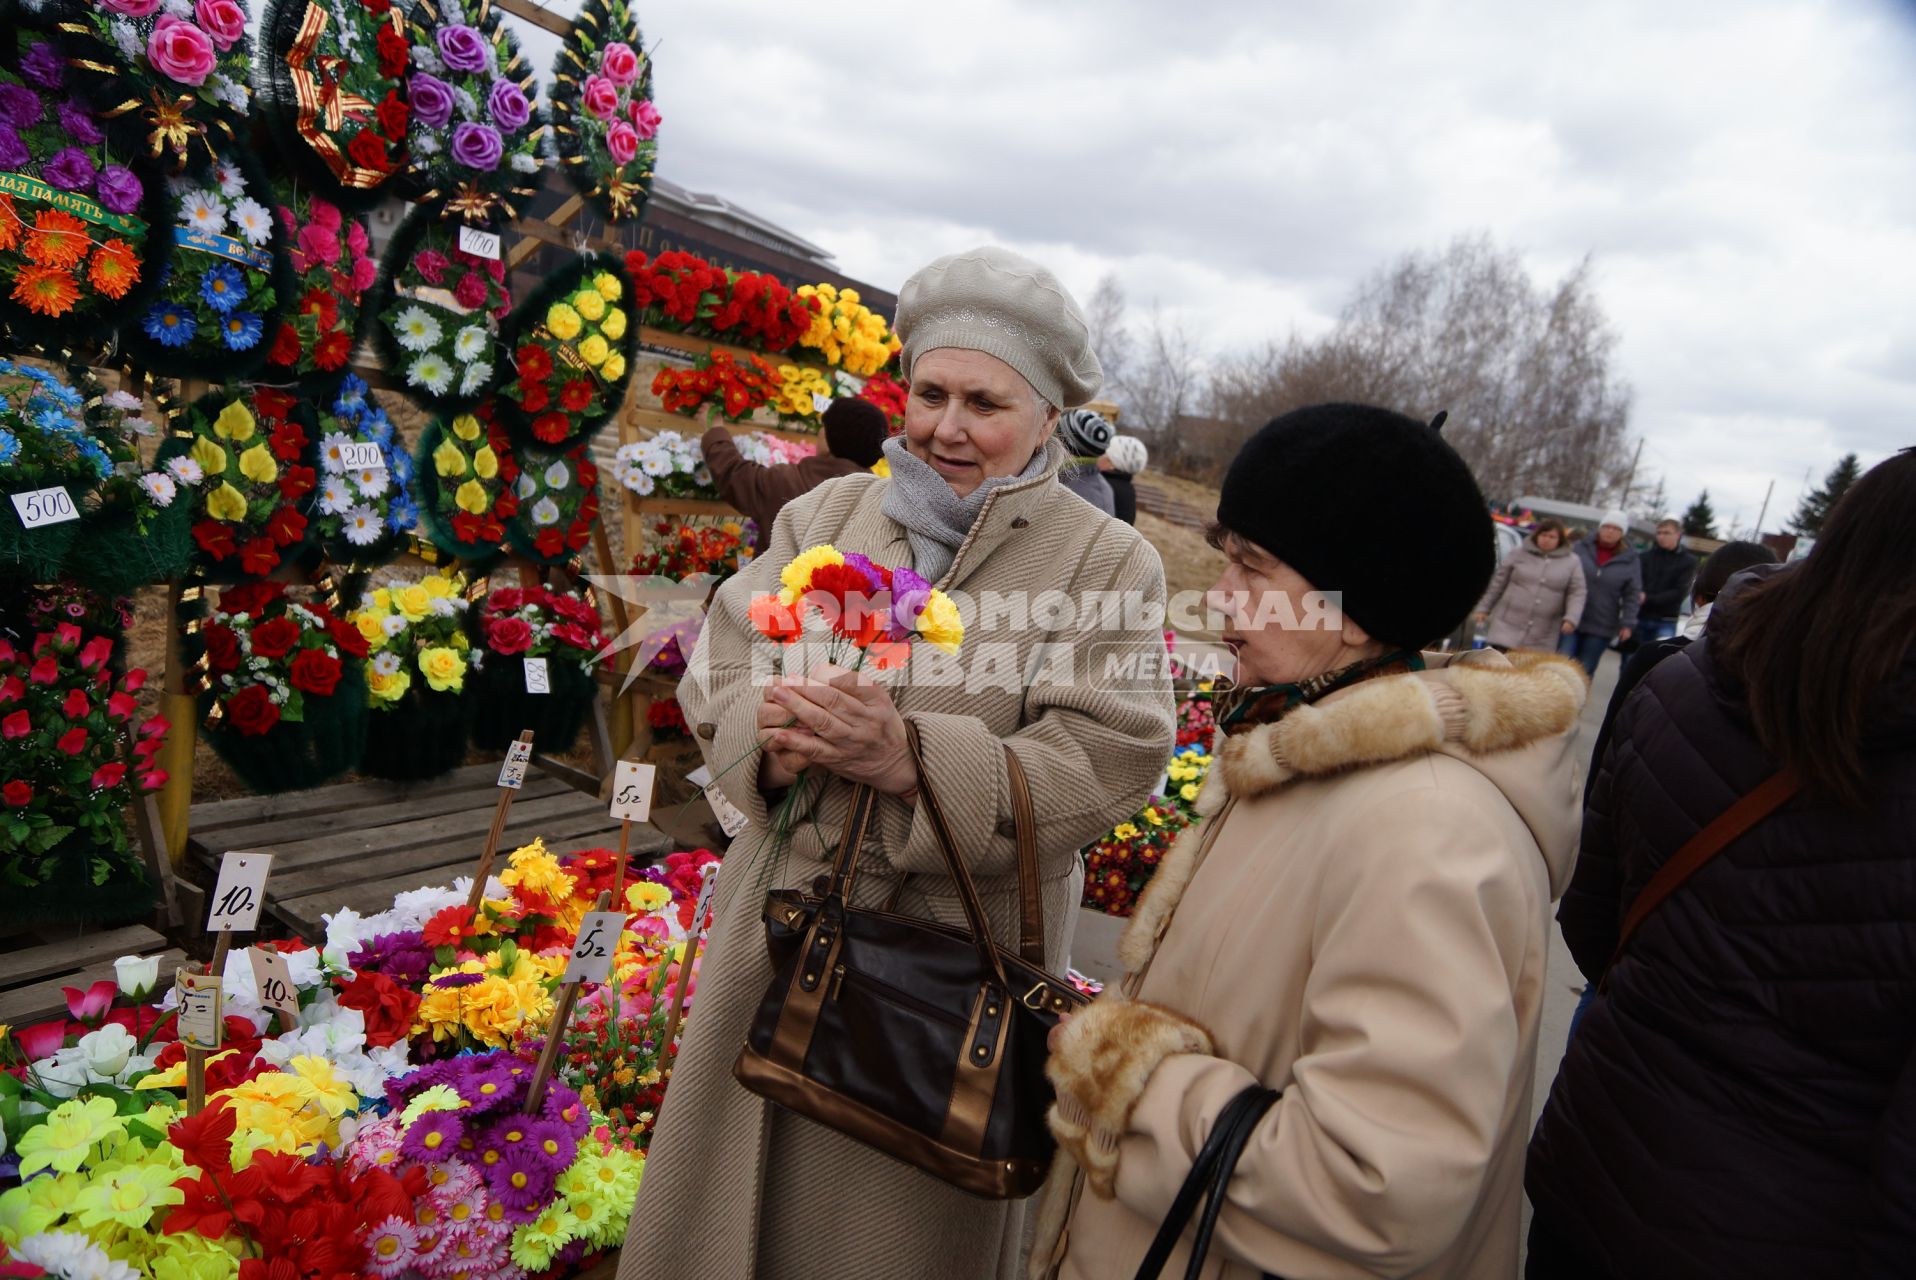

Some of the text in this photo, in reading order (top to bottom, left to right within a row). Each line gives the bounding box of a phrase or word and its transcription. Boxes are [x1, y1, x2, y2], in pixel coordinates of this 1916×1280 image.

[30, 185, 103, 219] ПАМЯТЬ
[344, 446, 378, 465] 200
[26, 492, 71, 522] 500
